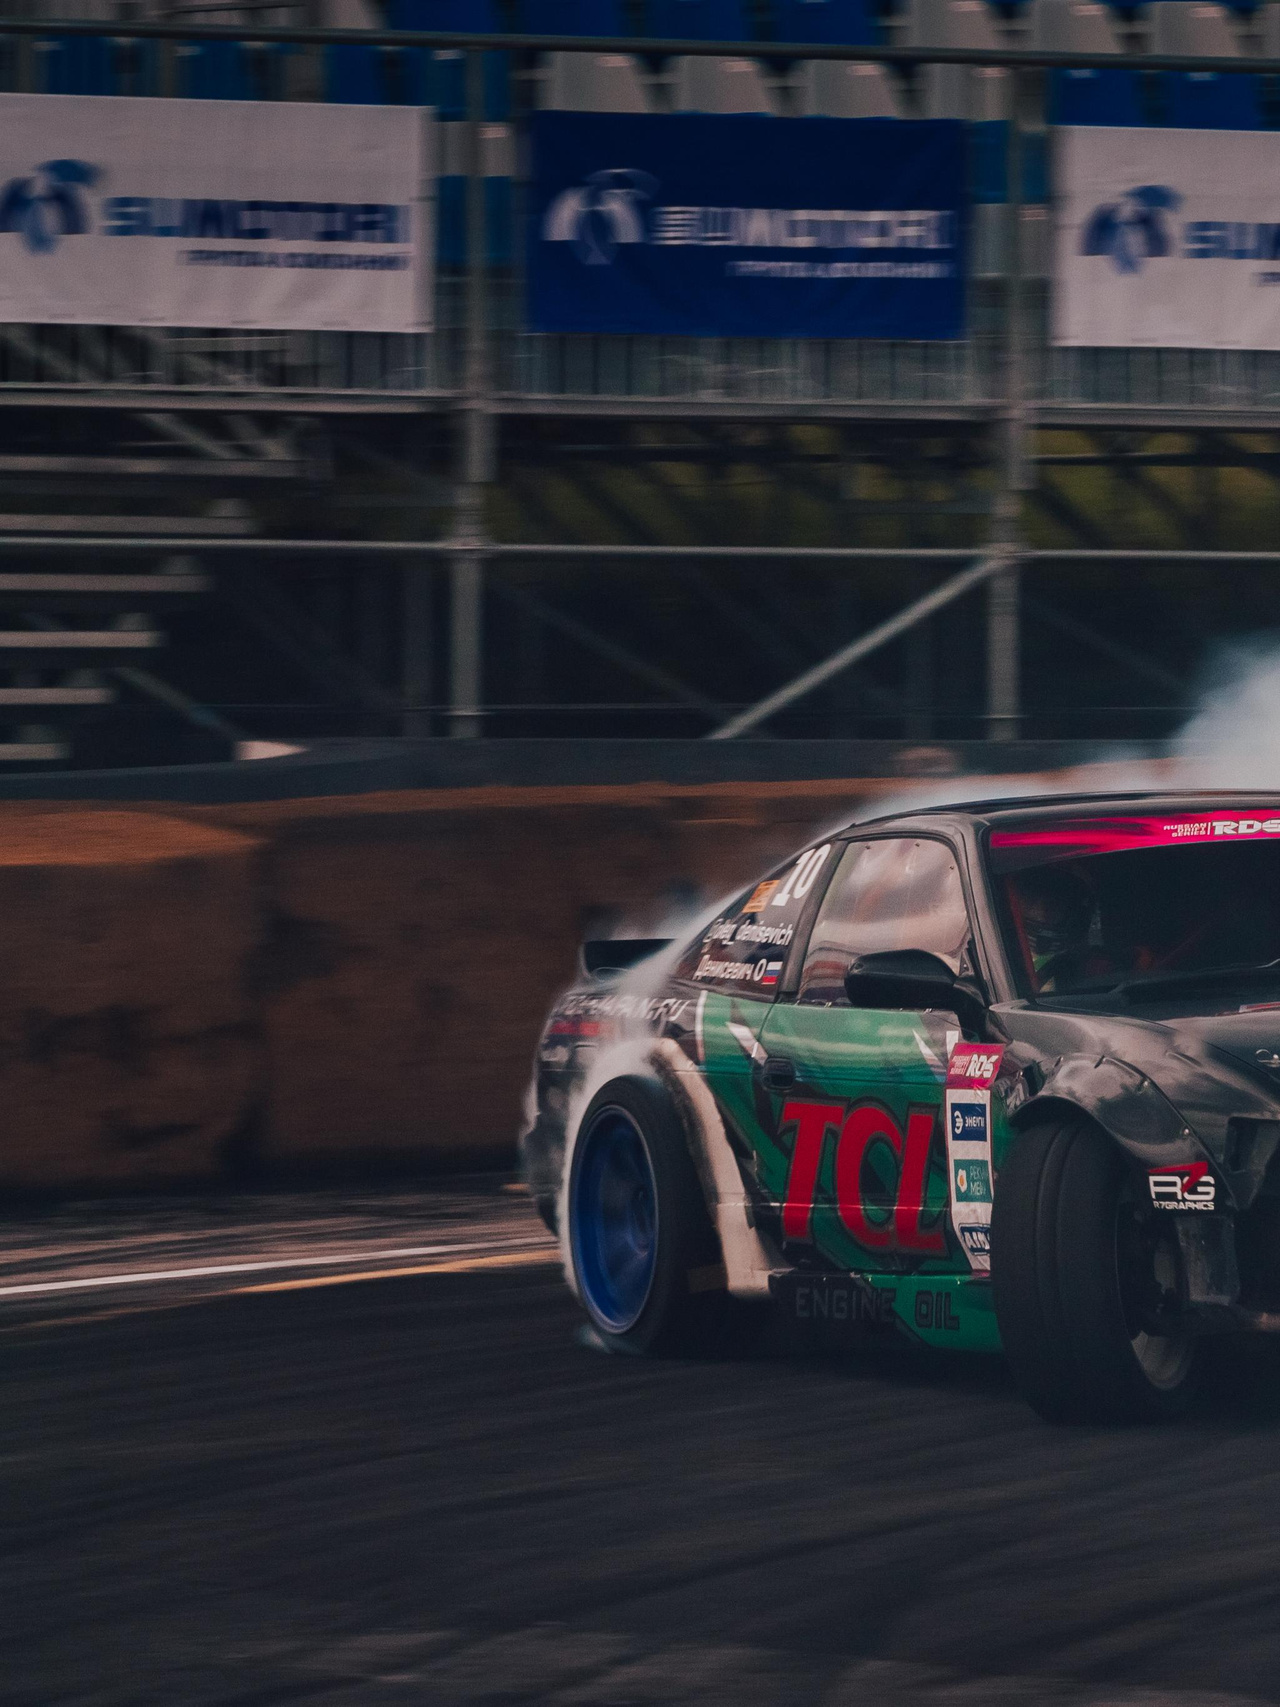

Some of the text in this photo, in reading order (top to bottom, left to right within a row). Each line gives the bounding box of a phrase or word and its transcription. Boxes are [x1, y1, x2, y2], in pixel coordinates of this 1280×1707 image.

[771, 843, 832, 907] 10
[781, 1101, 947, 1251] TCL
[795, 1287, 961, 1331] ENGINE OIL
